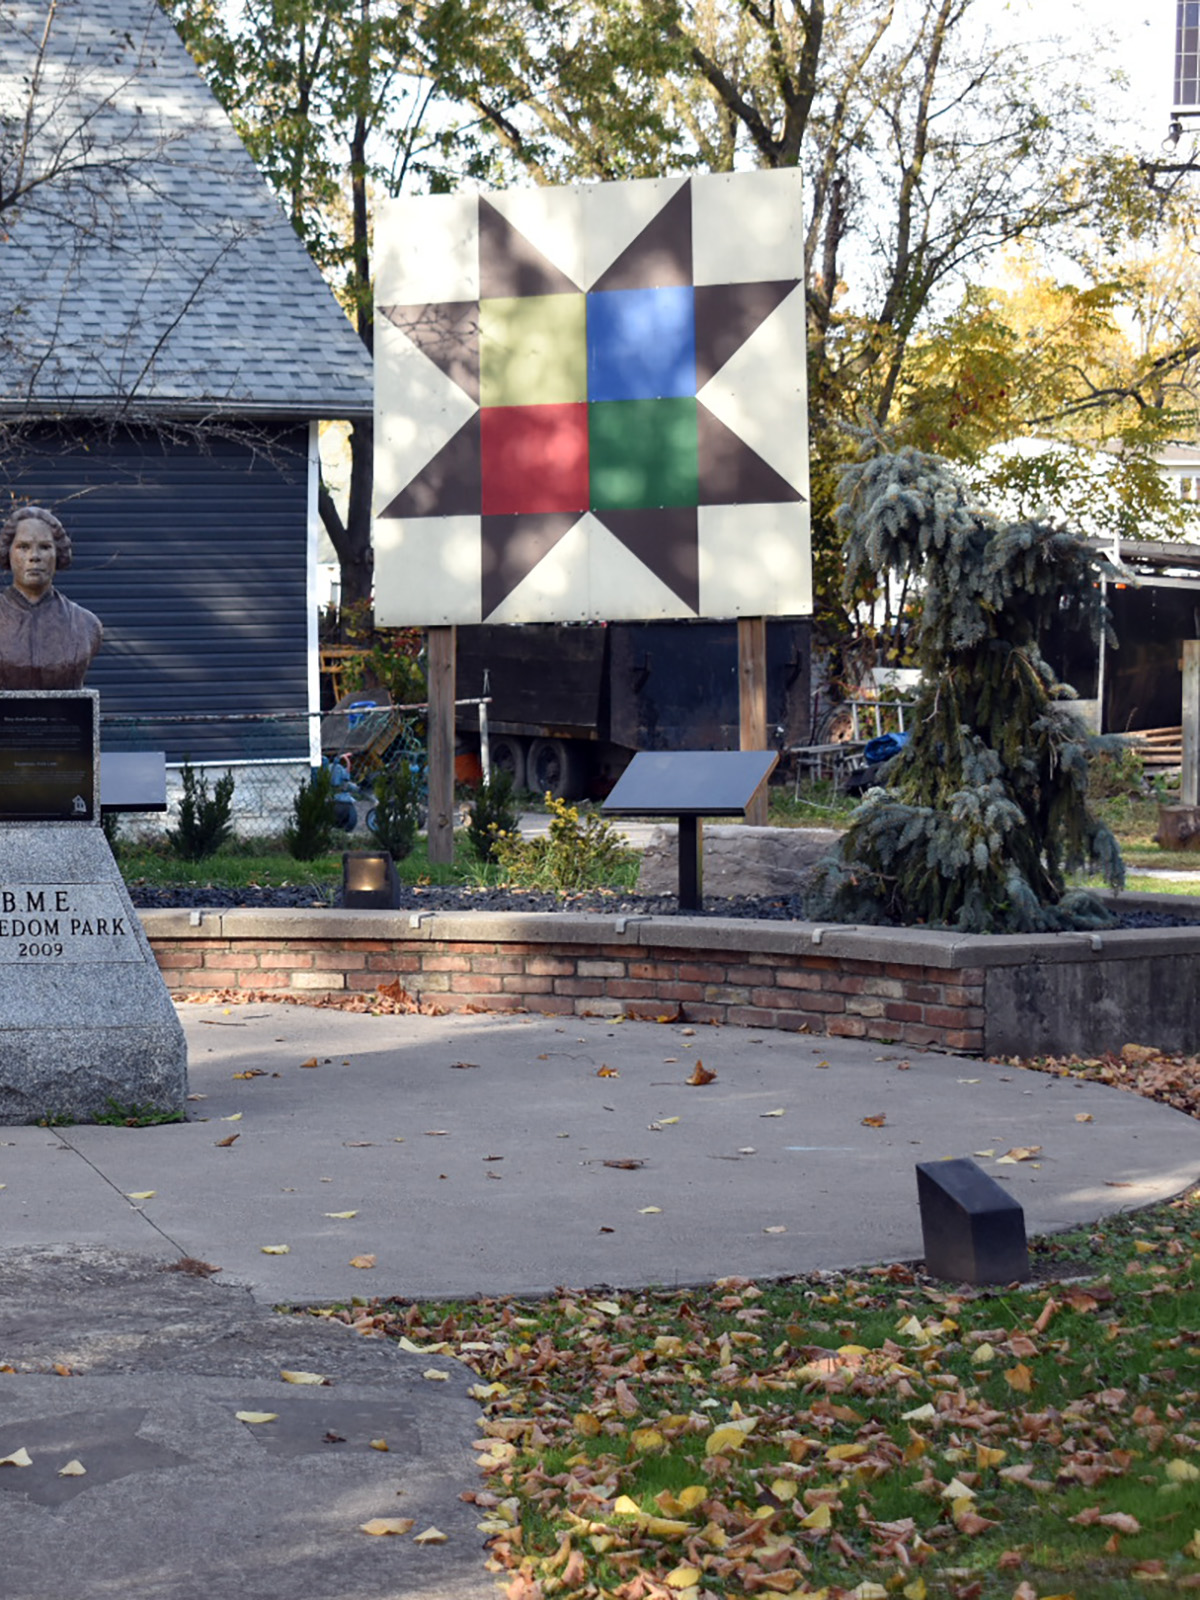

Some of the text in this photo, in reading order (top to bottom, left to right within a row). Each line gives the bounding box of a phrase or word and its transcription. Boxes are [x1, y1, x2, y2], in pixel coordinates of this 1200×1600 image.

[2, 891, 77, 913] B.M.E.
[71, 918, 126, 936] PARK
[18, 943, 64, 957] 2009
